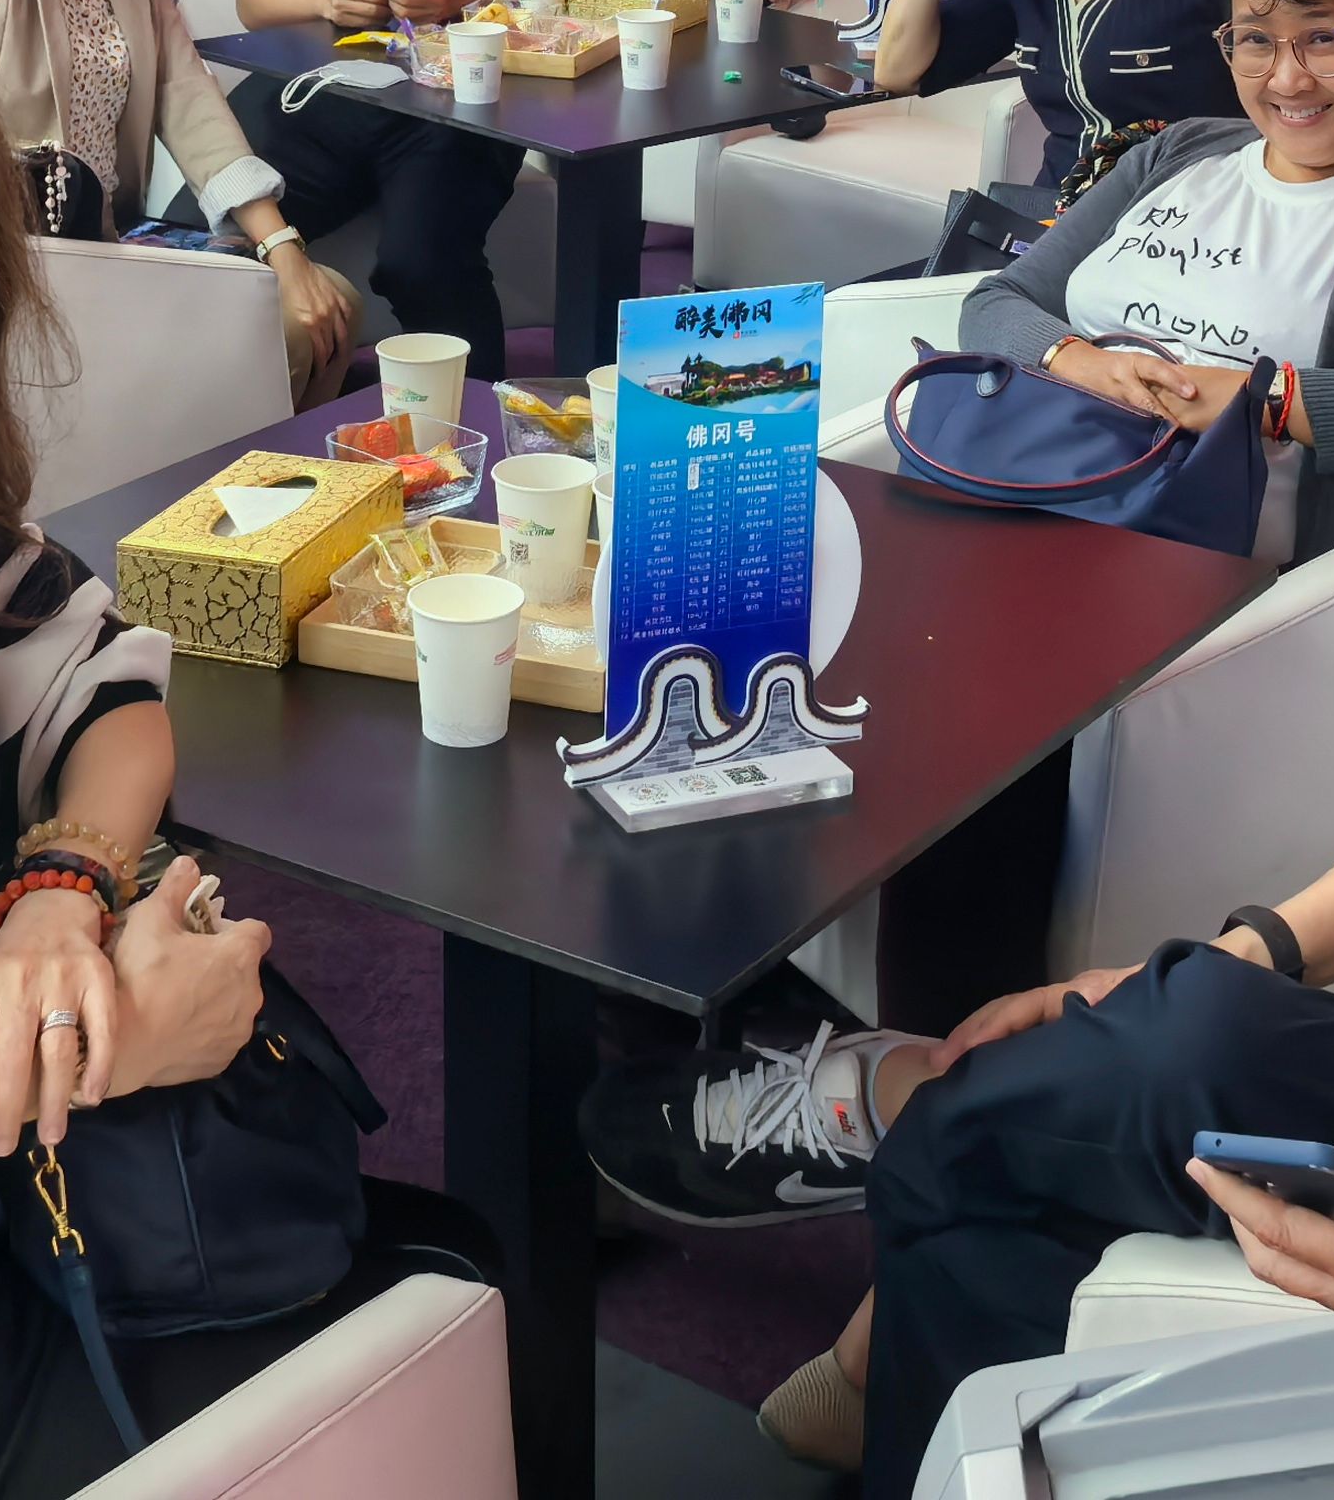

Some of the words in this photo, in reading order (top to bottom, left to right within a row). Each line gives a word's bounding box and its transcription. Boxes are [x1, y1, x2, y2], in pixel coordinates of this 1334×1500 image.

[1137, 206, 1190, 229] RM
[675, 299, 772, 339] 醉美佛冈
[686, 419, 757, 449] 佛冈号
